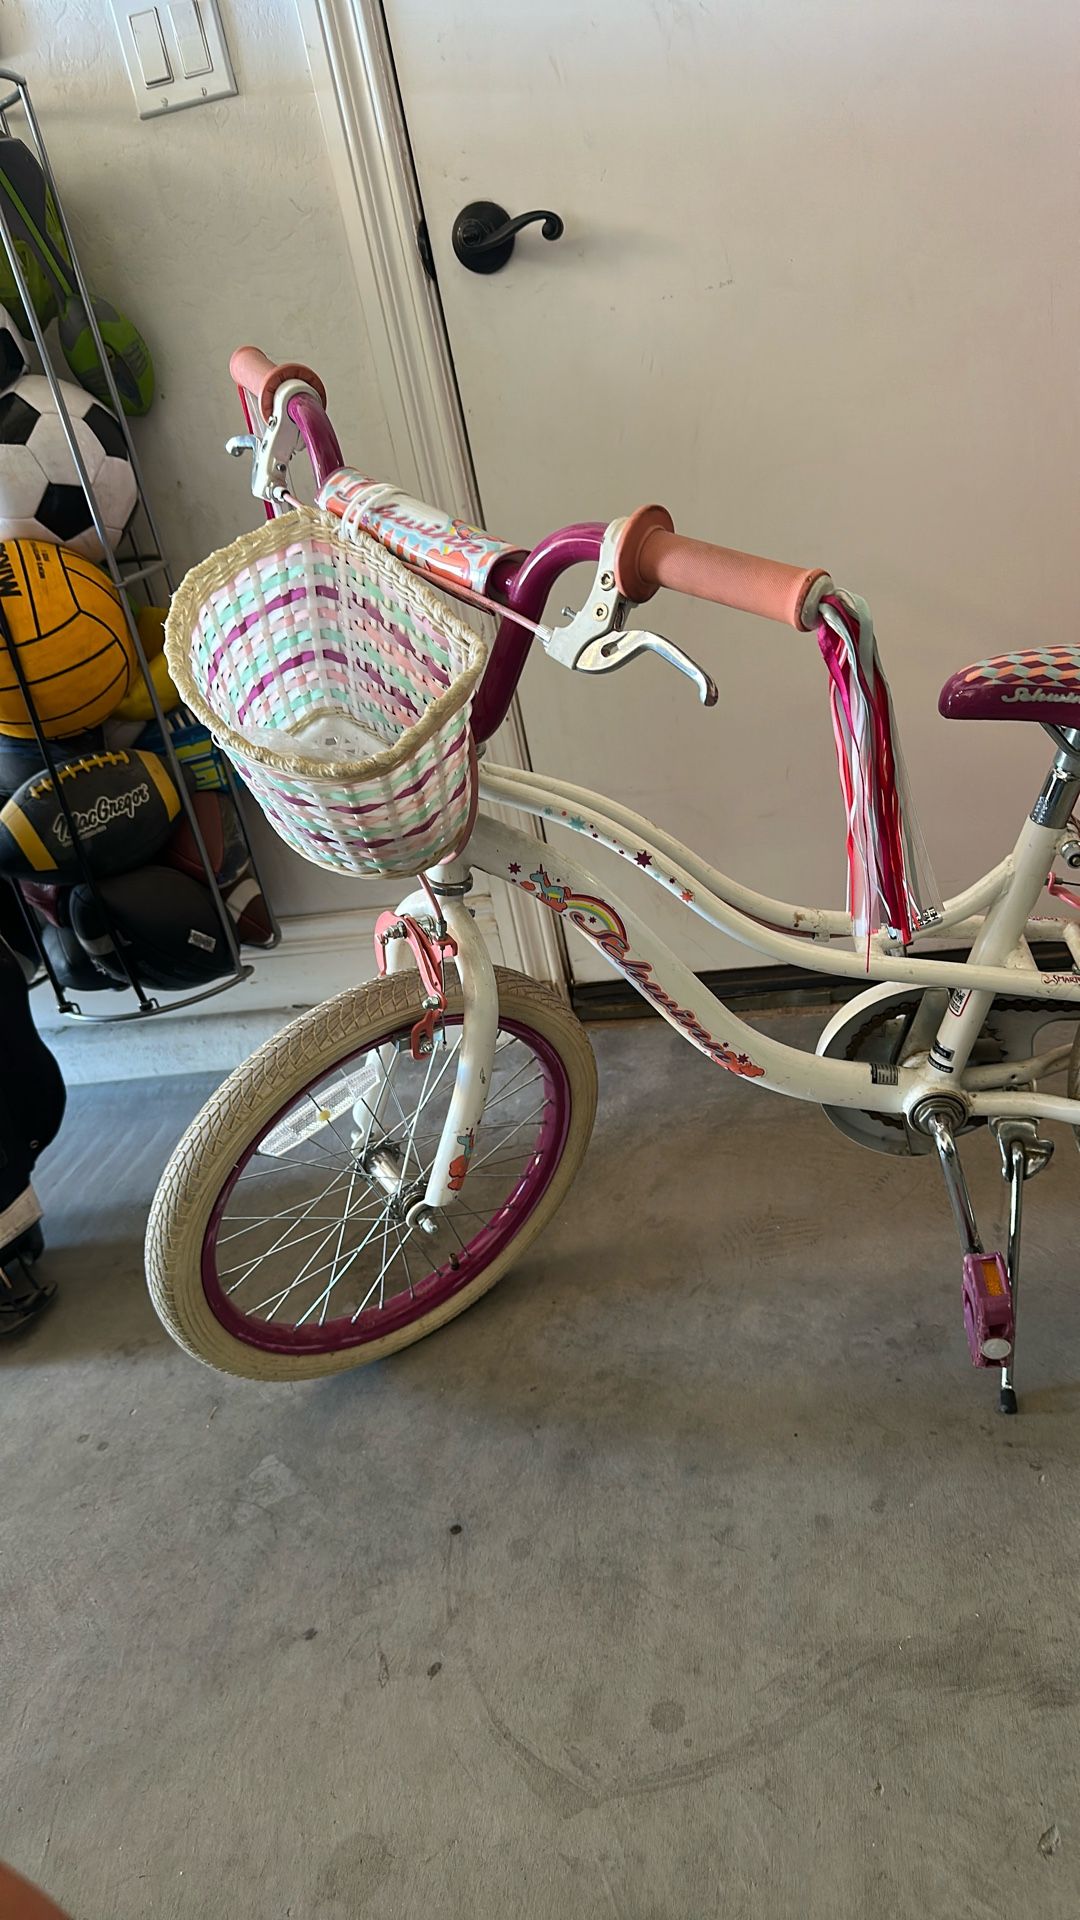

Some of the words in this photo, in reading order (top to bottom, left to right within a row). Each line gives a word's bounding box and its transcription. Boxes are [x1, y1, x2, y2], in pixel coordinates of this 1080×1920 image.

[335, 478, 484, 554] Shwinn
[53, 783, 150, 842] MacGregor
[569, 911, 733, 1064] Schwinn
